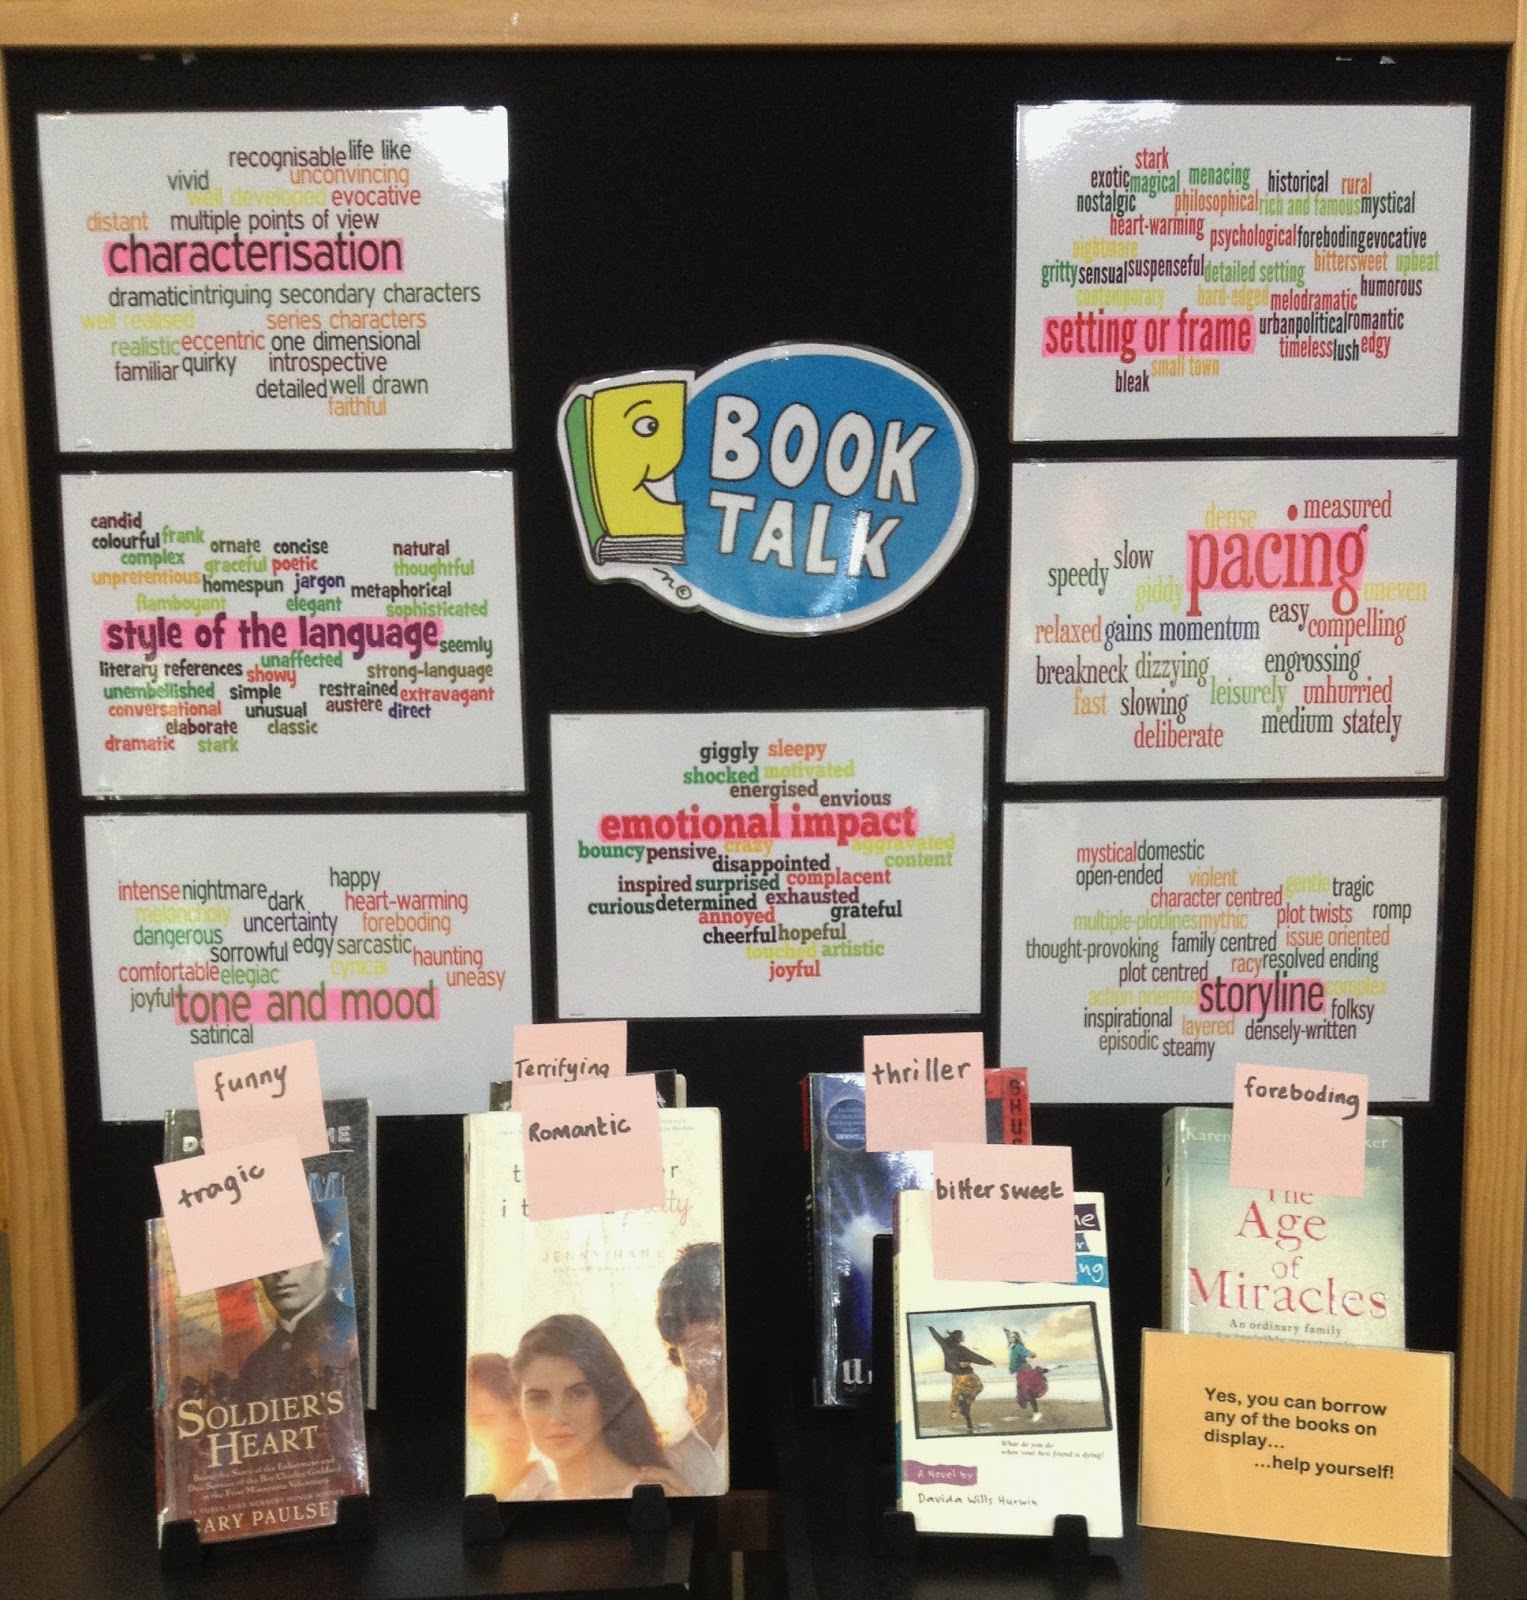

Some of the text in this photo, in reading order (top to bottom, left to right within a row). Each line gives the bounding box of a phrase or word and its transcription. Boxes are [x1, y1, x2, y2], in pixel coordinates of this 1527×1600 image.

[229, 147, 346, 172] recognisable
[349, 139, 411, 160] life like
[168, 170, 209, 191] vivid
[1091, 166, 1130, 189] exotic
[1268, 170, 1328, 193] historical
[1077, 190, 1136, 217] nostalgic
[1361, 191, 1415, 218] mystical
[170, 209, 379, 234] multiple points of view
[1110, 213, 1204, 241] heart-warming
[1210, 223, 1298, 251] psychological
[1298, 226, 1366, 253] foreboding
[1366, 228, 1427, 248] evocative
[108, 231, 402, 273] characterisation
[1078, 262, 1127, 284] sensual
[109, 286, 188, 307] dramatic
[190, 282, 480, 308] intriguing secondary characters
[1361, 275, 1422, 297] humorous
[271, 330, 420, 351] one dimensional
[1046, 307, 1252, 364] setting or frame
[1361, 331, 1391, 359] edgy
[269, 352, 387, 374] introspective
[330, 374, 428, 395] well drawn
[1116, 370, 1150, 393] bleak
[710, 393, 937, 506] BOOK
[1304, 491, 1392, 518] measured
[91, 512, 142, 529] candid
[92, 531, 160, 550] colourful
[709, 488, 902, 579] TALK
[274, 538, 328, 554] concise
[393, 539, 449, 556] natural
[1114, 540, 1153, 569] slow
[1186, 504, 1368, 617] pacing
[203, 576, 283, 594] homespun
[294, 574, 345, 594] jargon
[1048, 559, 1109, 595] speedy
[351, 580, 451, 602] metaphorical
[107, 612, 438, 661] style of the language
[1105, 615, 1259, 650] gains momentum
[440, 637, 493, 658] seemly
[100, 660, 242, 683] literary references
[367, 663, 493, 683] strong-language
[1036, 654, 1128, 684] breakneck
[1265, 645, 1361, 681] engrossing
[230, 683, 281, 703] simple
[319, 681, 397, 698] restrained
[1304, 675, 1392, 704] unhurried
[246, 702, 307, 718] unusual
[1121, 688, 1188, 724] slowing
[1262, 705, 1402, 742] medium stately
[700, 741, 759, 764] giggly
[683, 767, 759, 784] shocked
[820, 789, 891, 806] envious
[600, 803, 917, 846] emotional impact
[578, 841, 646, 862] bouncy
[646, 843, 716, 863] pensive
[1137, 839, 1205, 862] domestic
[712, 854, 830, 876] disappointed
[1076, 863, 1163, 891] open-ended
[330, 867, 380, 891] happy
[695, 873, 780, 895] surprised
[1333, 877, 1374, 900] tragic
[182, 879, 267, 905] nightmare
[268, 891, 305, 912] dark
[345, 890, 468, 914] heart-warming
[656, 893, 757, 912] determined
[588, 899, 655, 915] curious
[830, 900, 902, 922] grateful
[1373, 903, 1411, 923] romp
[244, 912, 337, 936] uncertainty
[703, 925, 776, 944] cheerful
[210, 941, 288, 963] sorrowful
[1026, 938, 1158, 964] thought-provoking
[1172, 931, 1276, 957] family centred
[1263, 949, 1379, 974] resolved ending
[1119, 961, 1208, 987] plot centred
[175, 980, 434, 1023] tone and mood
[1200, 970, 1324, 1023] storyline
[1084, 1007, 1172, 1030] inspirational
[1331, 998, 1374, 1025] folksy
[190, 1024, 253, 1045] satirical
[1245, 1019, 1356, 1045] densely-written
[515, 1057, 610, 1082] Terrifying
[872, 1058, 971, 1085] thriller
[214, 1064, 287, 1101] funny
[1244, 1076, 1360, 1121] foreboding
[528, 1113, 631, 1142] Romantic
[178, 1165, 264, 1208] tragic
[1236, 1200, 1327, 1252] Age
[1272, 1256, 1303, 1279] of
[1189, 1267, 1387, 1319] Miracles
[1230, 1319, 1342, 1337] An ordinary family
[1205, 1387, 1387, 1416] Yes, you can borrow
[178, 1391, 344, 1439] SOLDIER'S
[1205, 1410, 1377, 1436] any of the books on
[208, 1425, 319, 1468] HEART
[929, 1471, 955, 1479] Novel
[959, 1471, 973, 1480] by
[1315, 1462, 1394, 1479] yourself!
[918, 1493, 962, 1503] Davida
[968, 1495, 992, 1504] Wills
[253, 1500, 337, 1526] PAULSE
